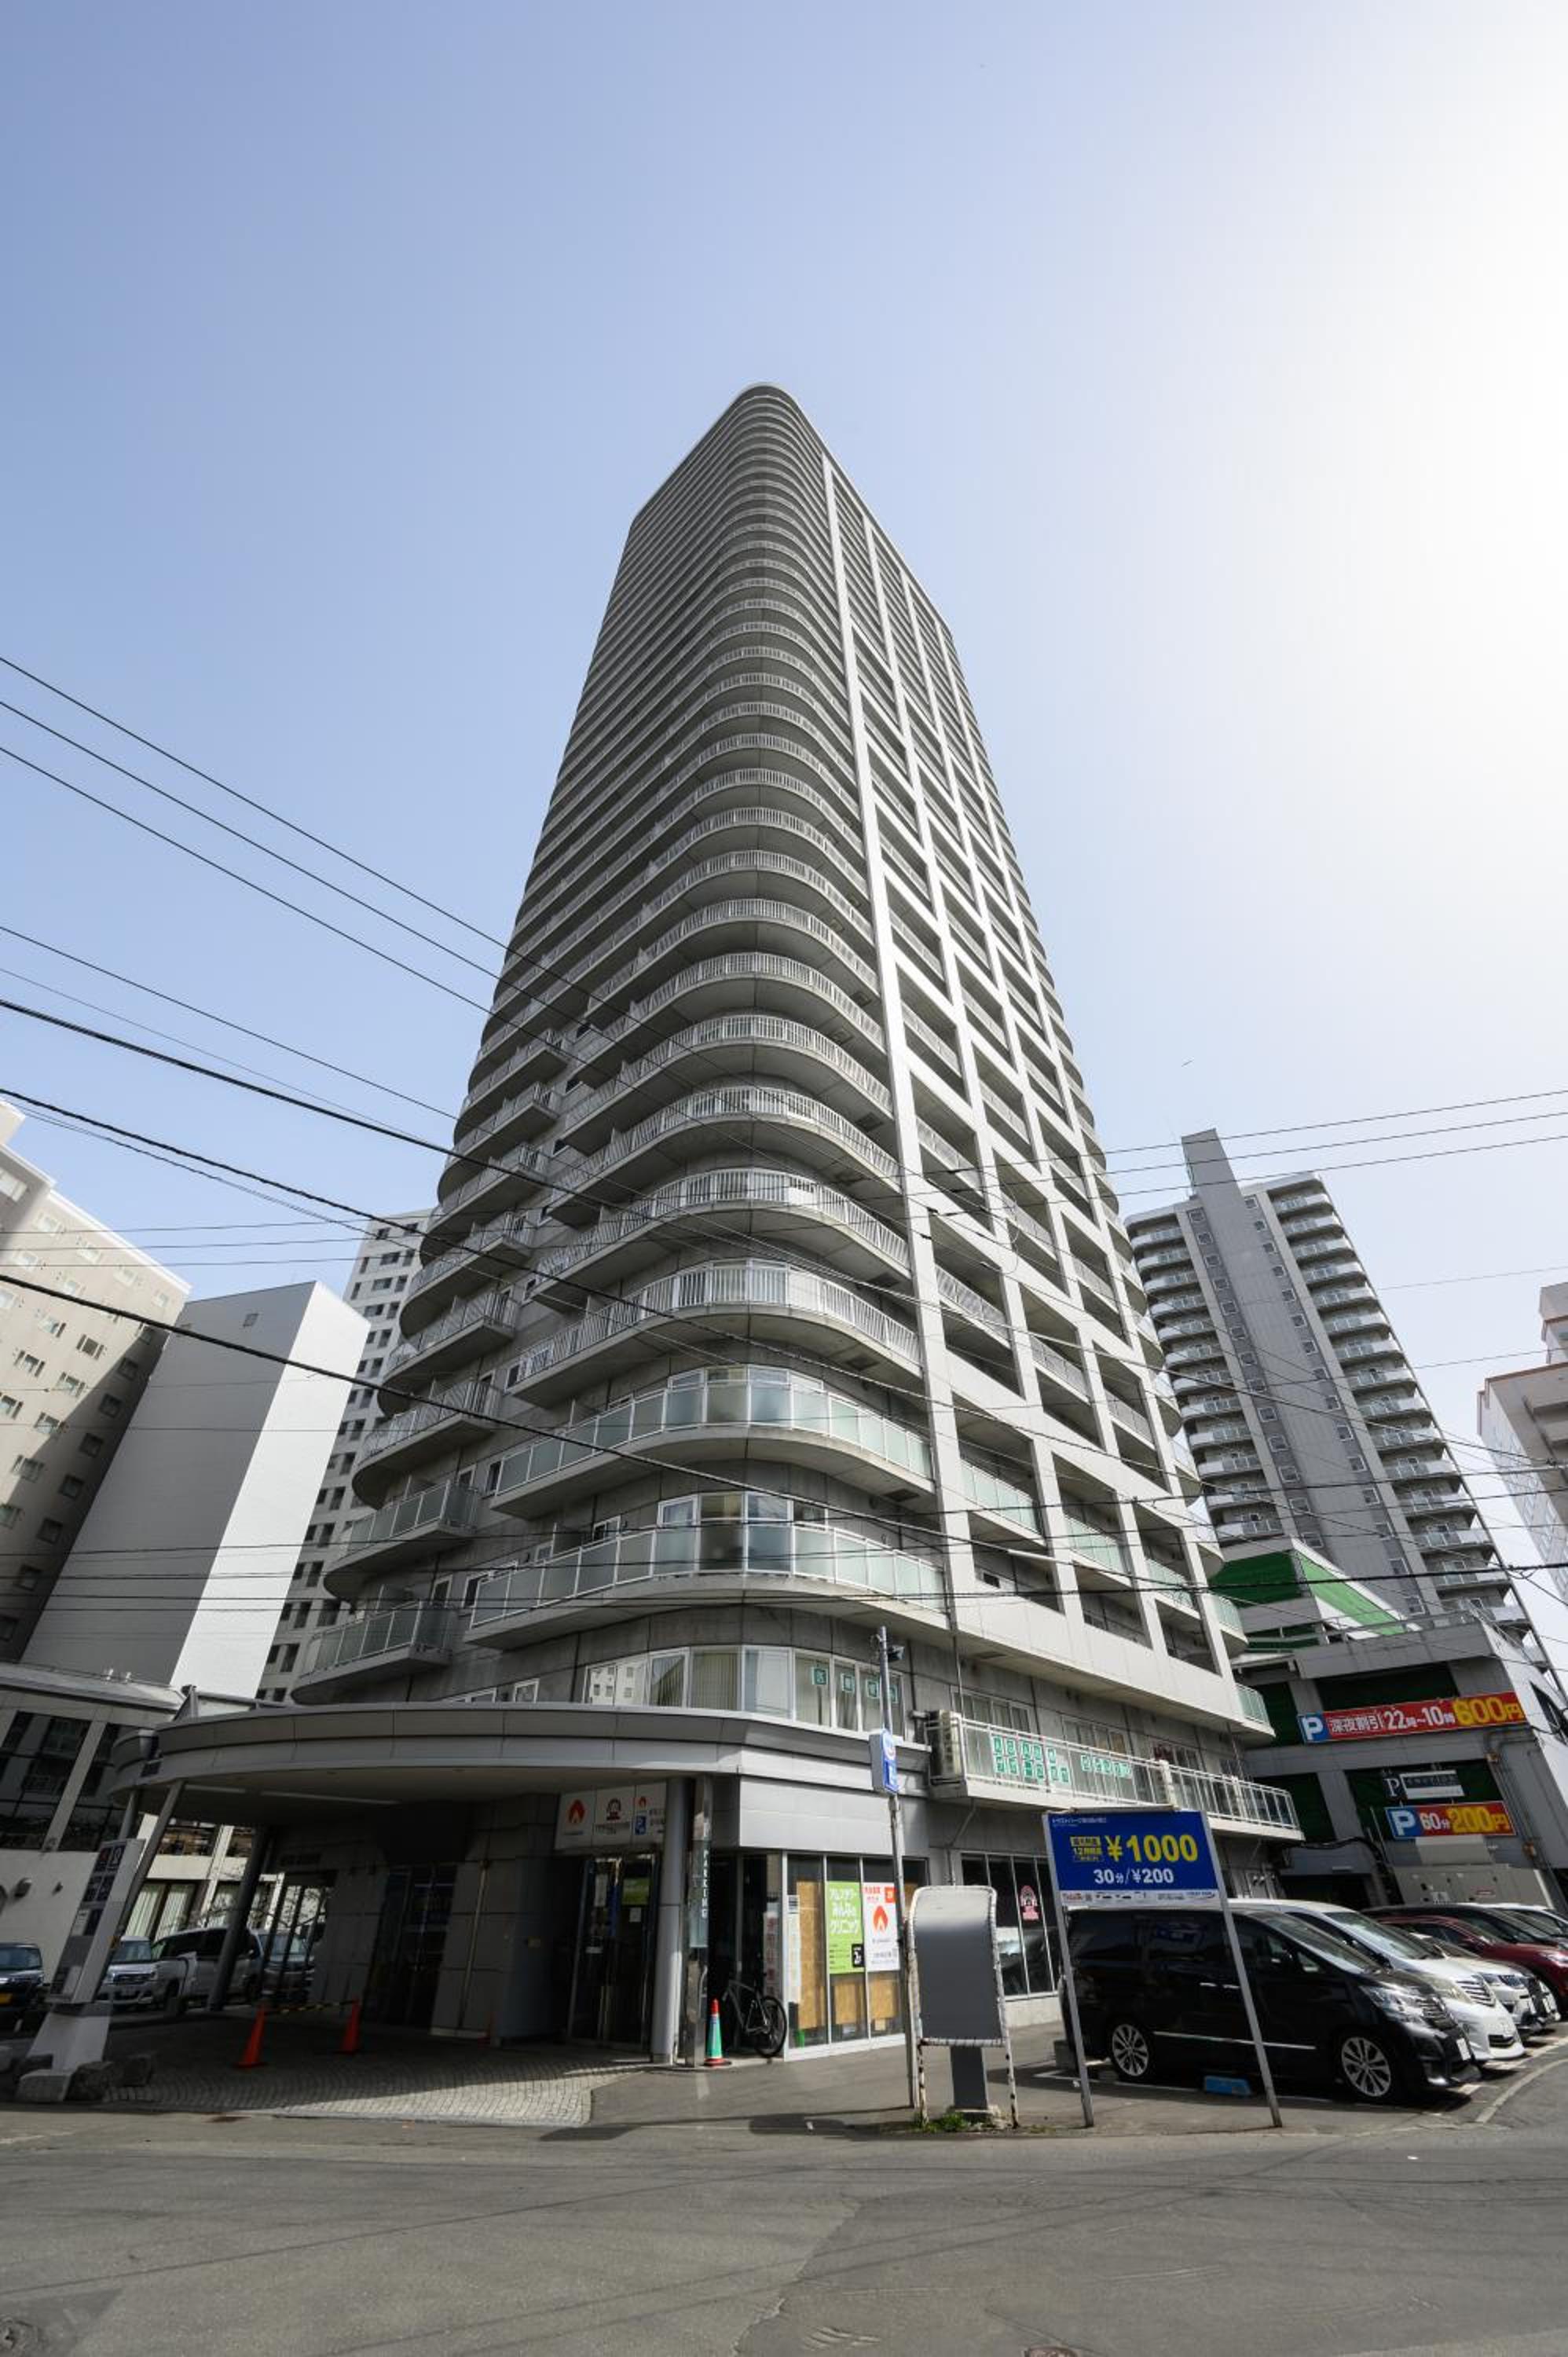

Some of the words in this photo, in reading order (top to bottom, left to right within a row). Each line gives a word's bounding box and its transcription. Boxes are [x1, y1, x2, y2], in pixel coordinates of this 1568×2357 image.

[1302, 1716, 1324, 1740] P
[1453, 1697, 1525, 1726] 600円
[1391, 1809, 1416, 1836] P
[1446, 1806, 1510, 1833] 200円
[1105, 1835, 1198, 1862] ¥1000
